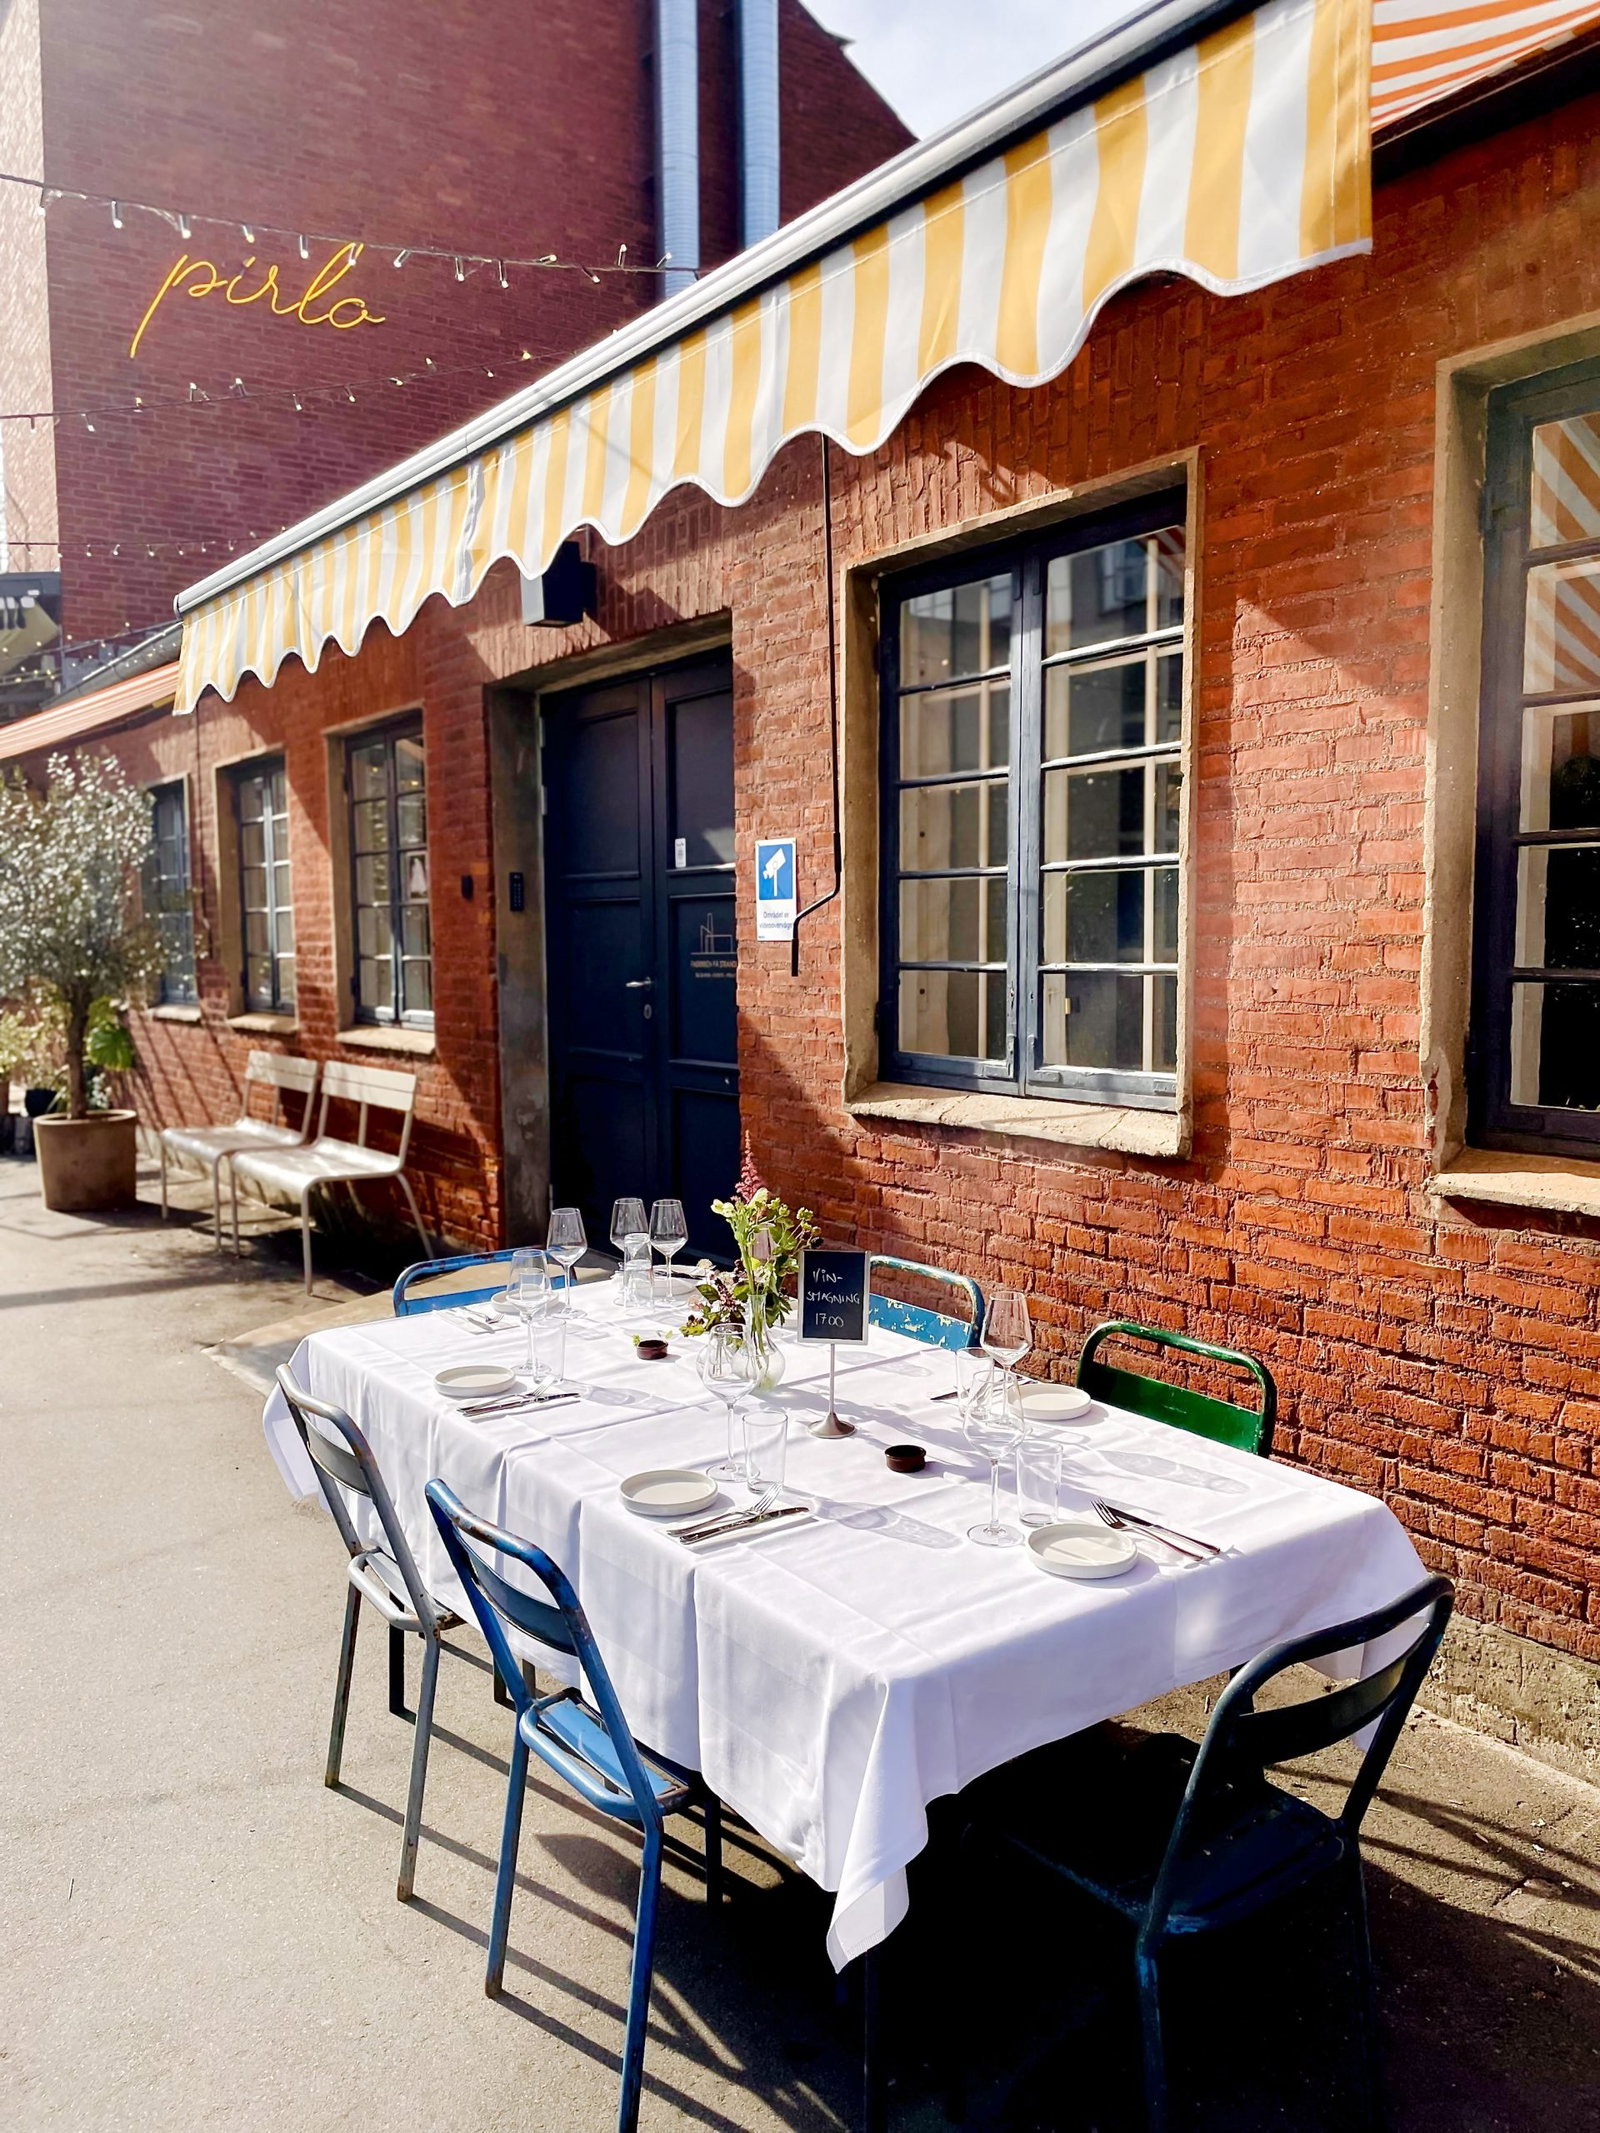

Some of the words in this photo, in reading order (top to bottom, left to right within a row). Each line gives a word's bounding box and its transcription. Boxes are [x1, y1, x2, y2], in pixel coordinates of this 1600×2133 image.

[130, 242, 387, 359] pirlo
[806, 1290, 861, 1305] SMAGNING
[815, 1312, 845, 1328] 1700
